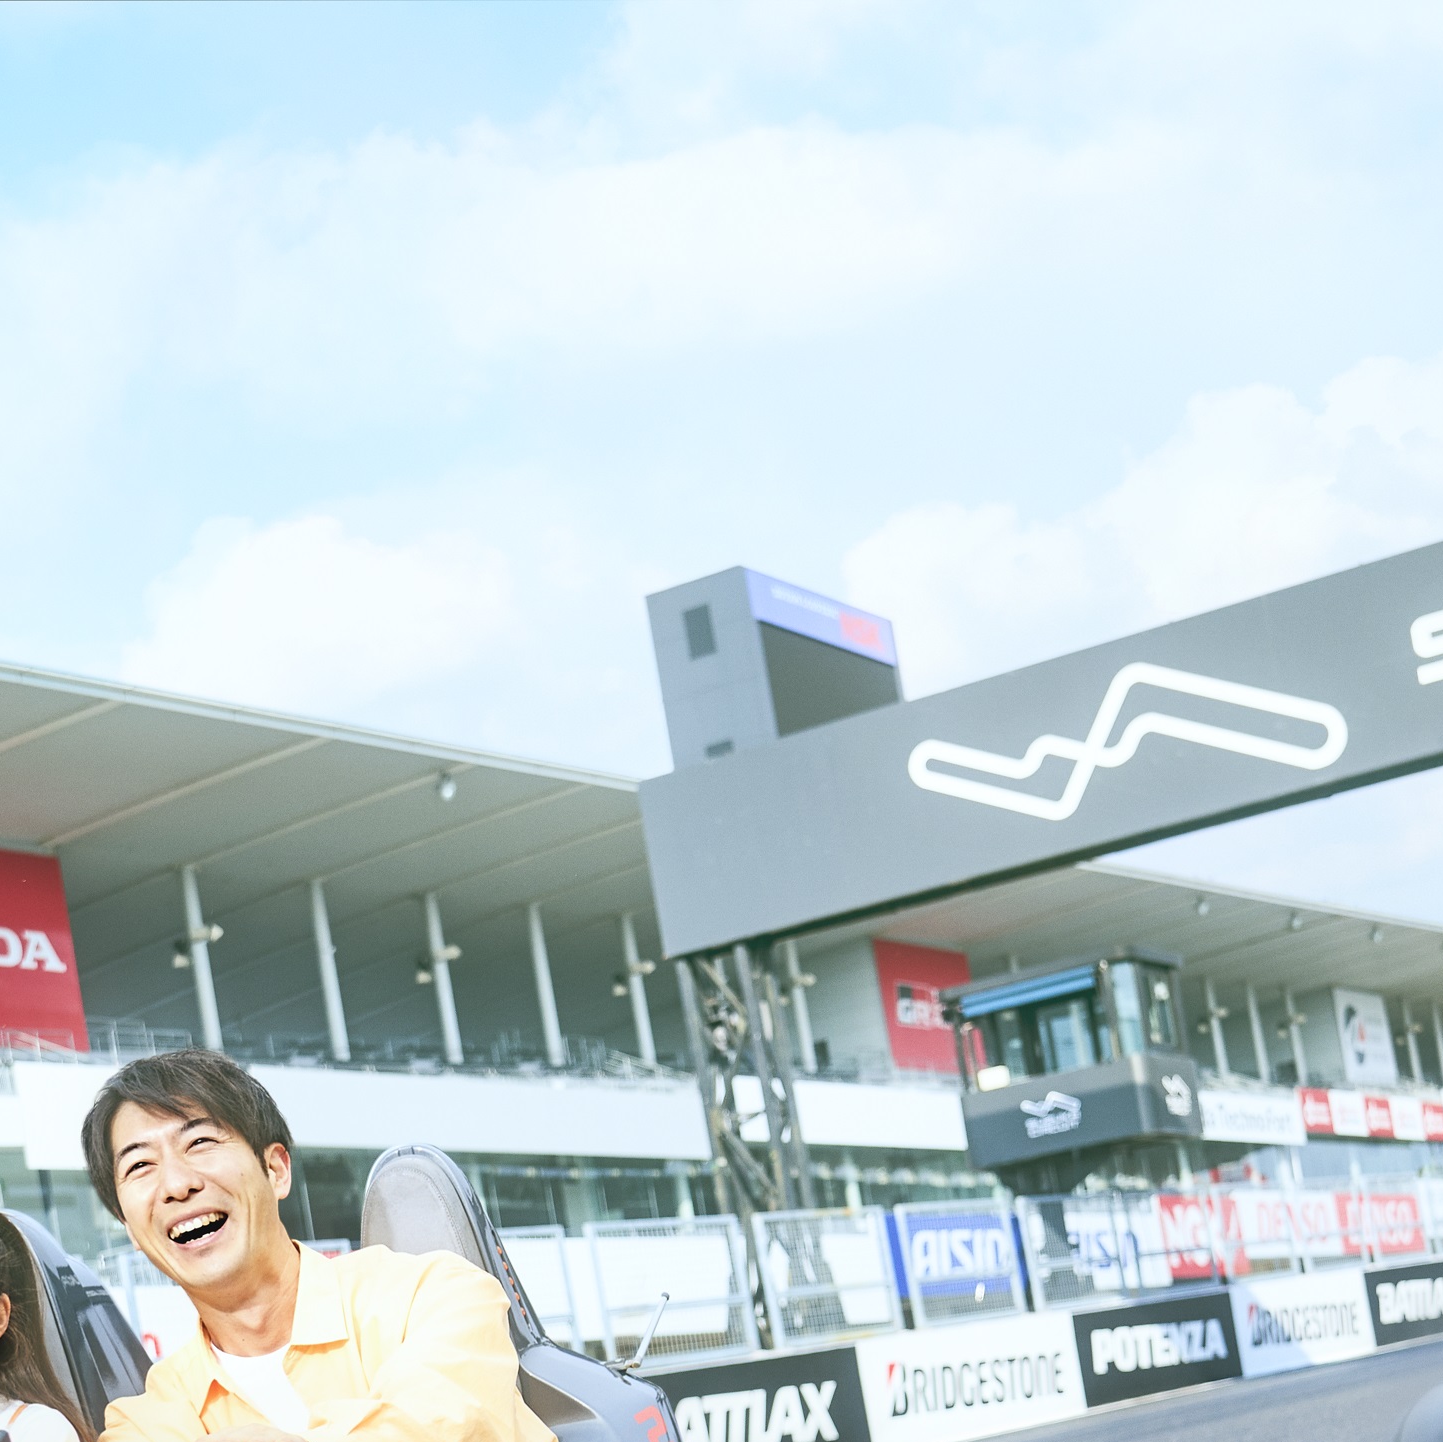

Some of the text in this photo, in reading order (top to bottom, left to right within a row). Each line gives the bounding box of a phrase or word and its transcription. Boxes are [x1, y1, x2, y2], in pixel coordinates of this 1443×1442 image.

[1090, 1317, 1228, 1376] POTENZA
[1248, 1300, 1359, 1347] BRIDGESTONE
[886, 1346, 1065, 1418] BRIDGESTONE
